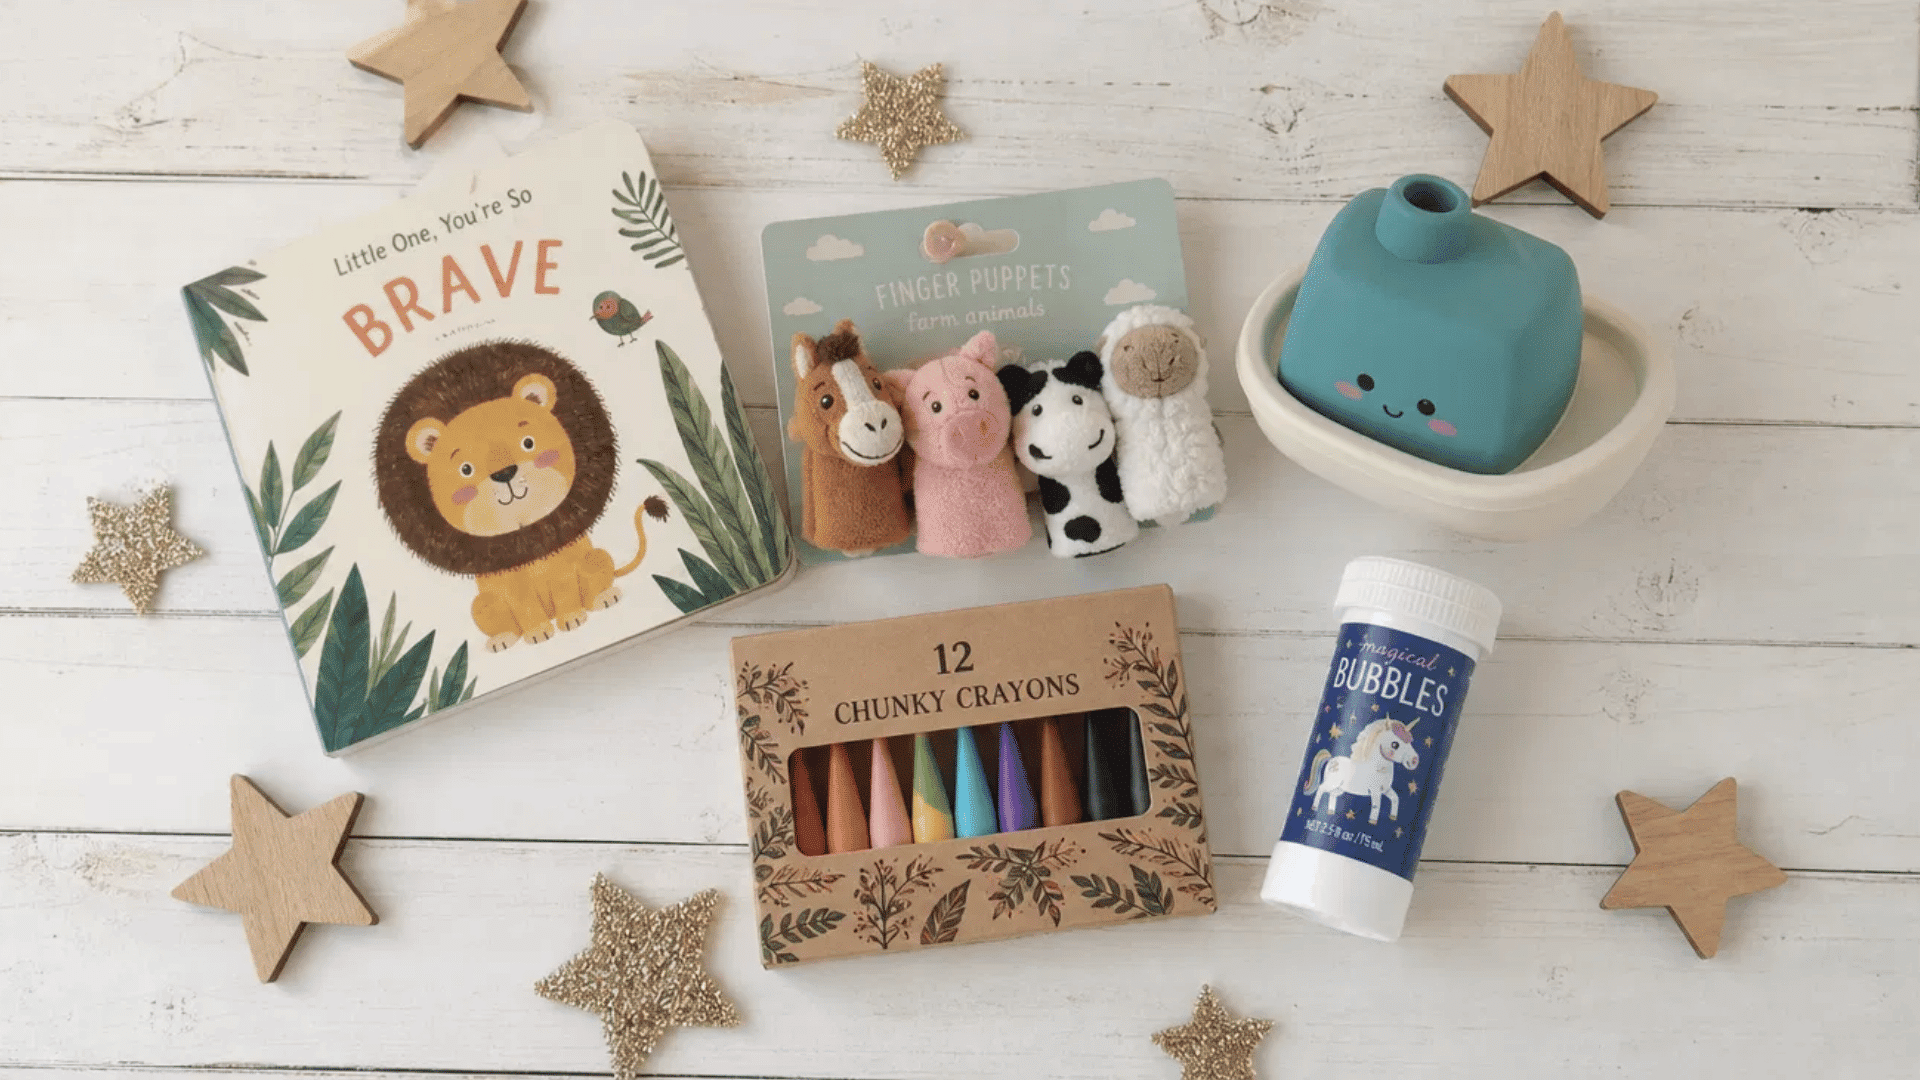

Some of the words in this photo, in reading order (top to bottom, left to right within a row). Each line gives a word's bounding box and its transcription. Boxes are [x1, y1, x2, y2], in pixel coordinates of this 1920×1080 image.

[334, 243, 387, 277] Little
[391, 230, 438, 253] One,
[439, 201, 503, 234] You're
[507, 188, 532, 209] So
[341, 238, 563, 358] BRAVE
[875, 272, 961, 310] FINGER
[970, 264, 1071, 295] PUPPETS
[908, 311, 961, 332] farm
[965, 297, 1045, 325] animals
[933, 640, 974, 675] 12
[1360, 641, 1440, 671] magical
[834, 689, 946, 725] CHUNKY
[956, 673, 1080, 709] CRAYONS
[1333, 657, 1448, 717] BUBBLES
